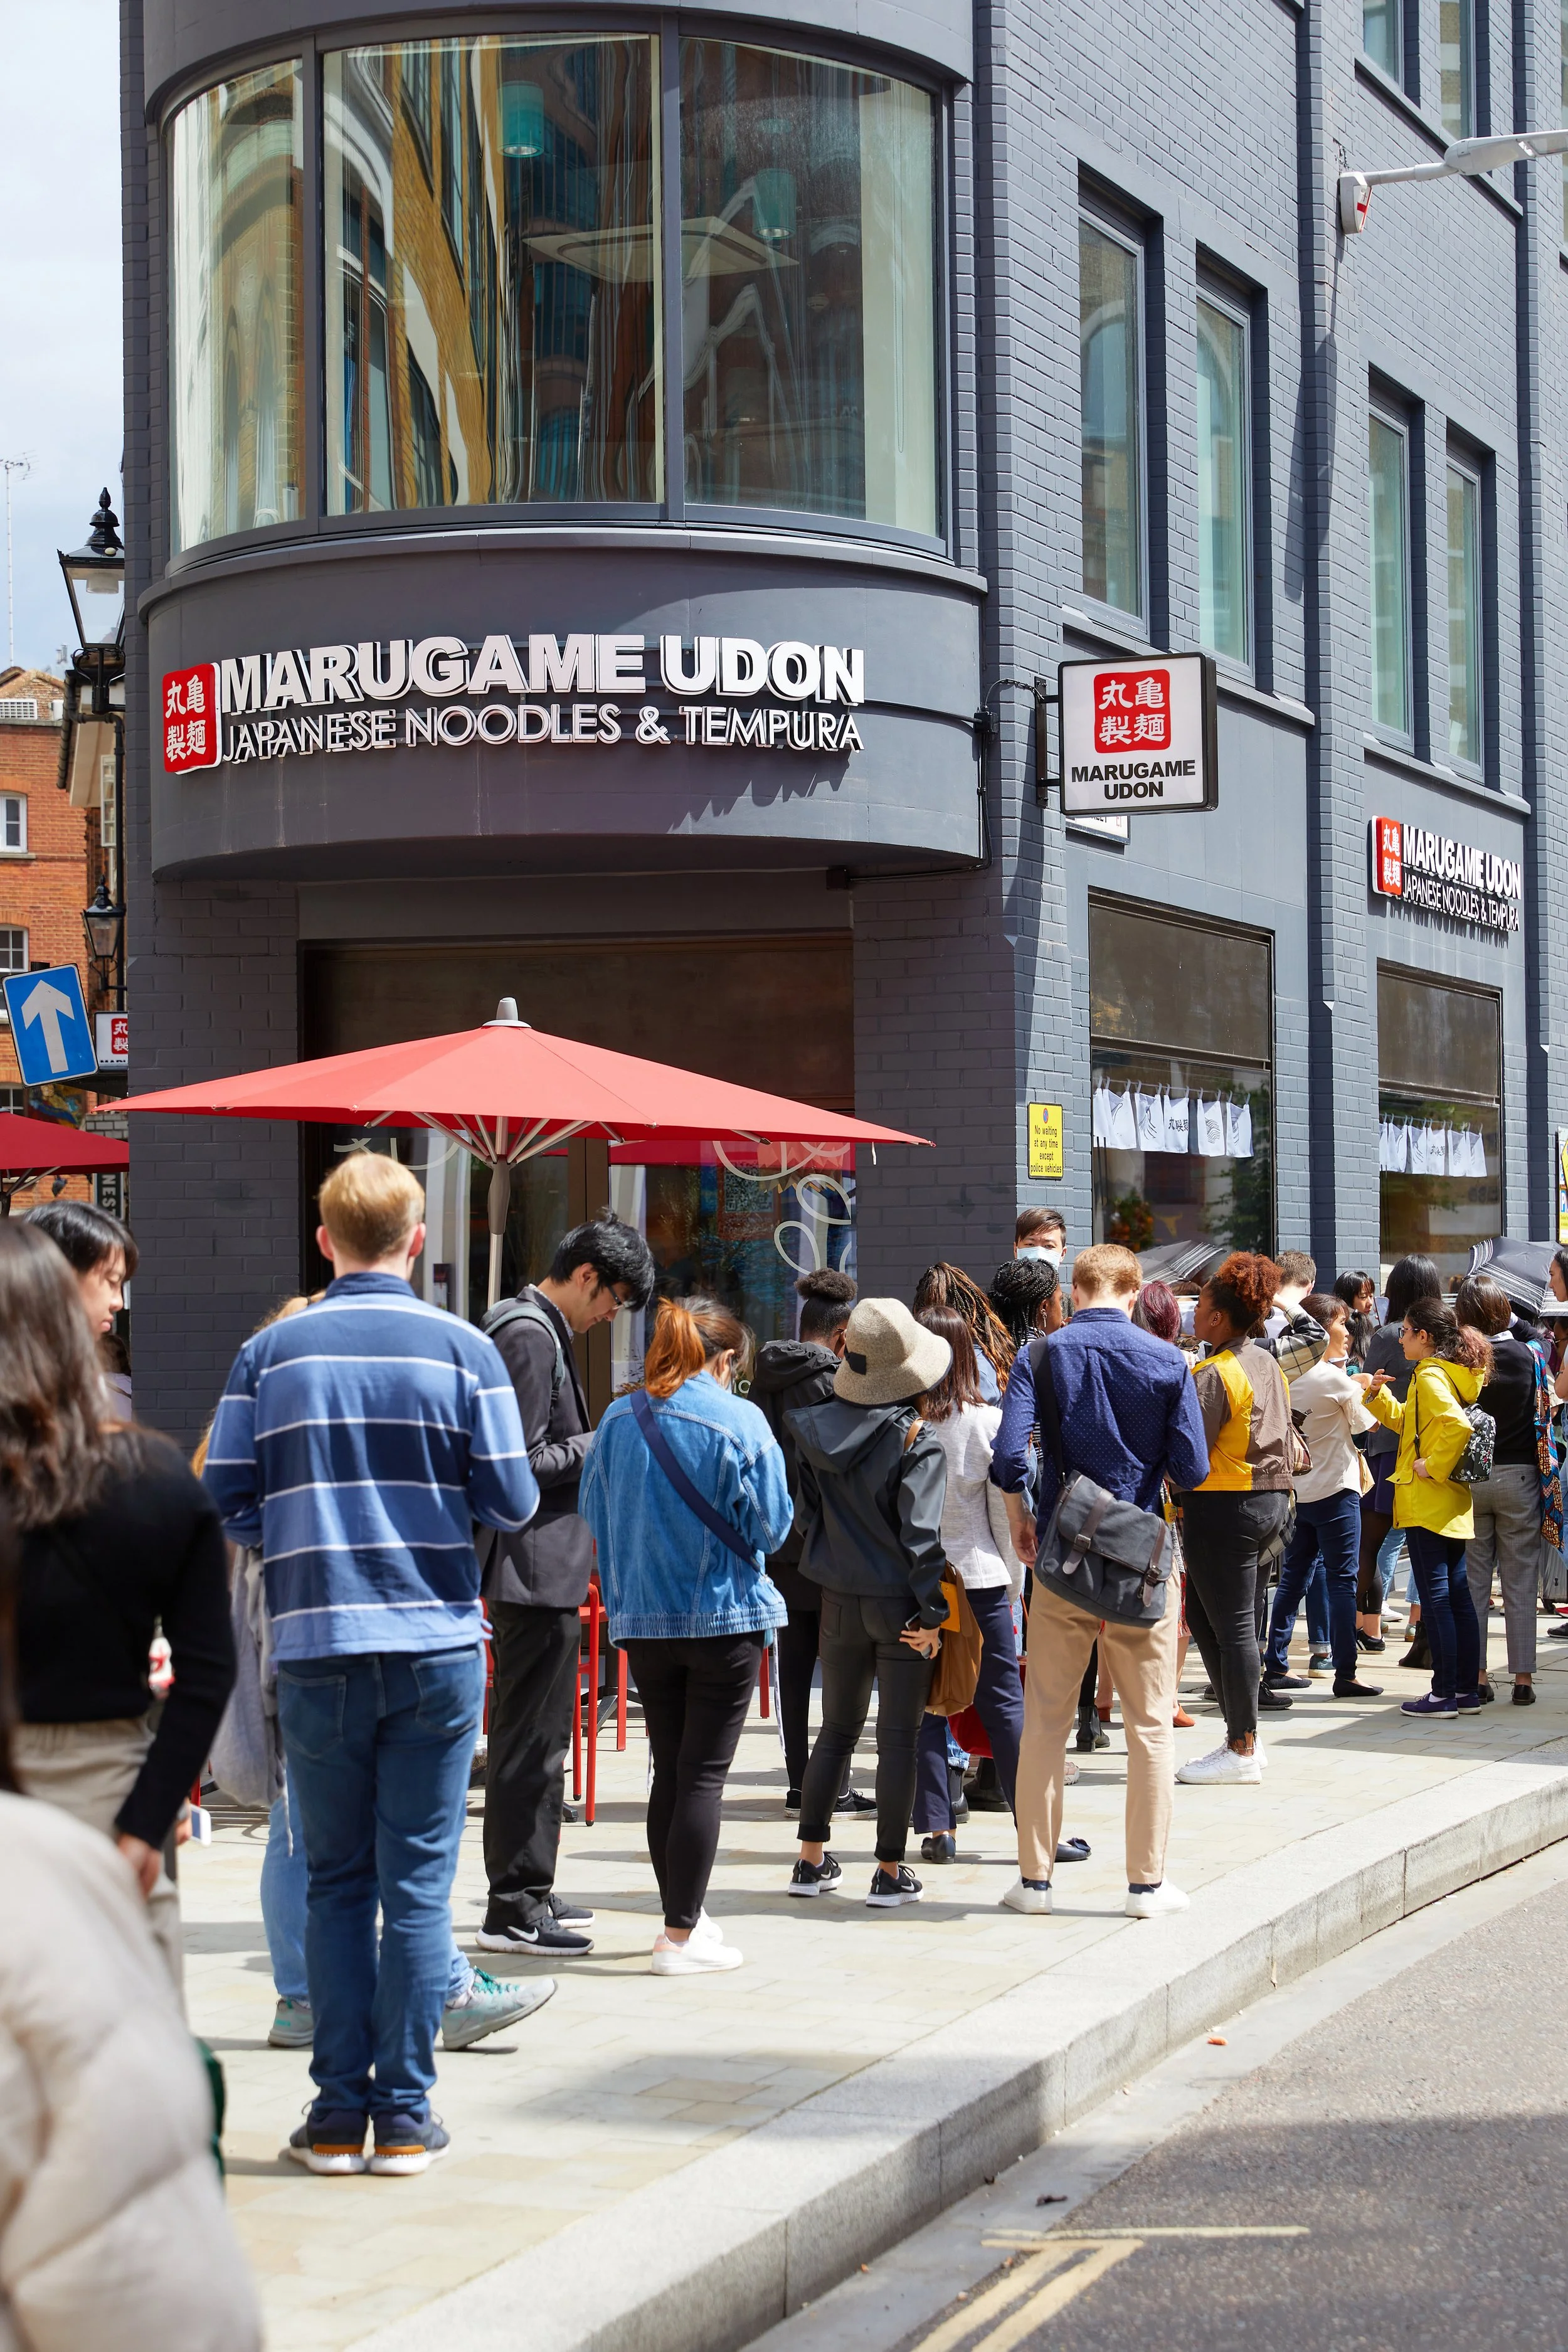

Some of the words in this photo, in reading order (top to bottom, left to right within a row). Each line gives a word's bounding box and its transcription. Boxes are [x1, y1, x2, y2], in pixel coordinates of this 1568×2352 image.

[221, 634, 646, 714] MARUGAME
[661, 635, 865, 705] UDON
[164, 674, 206, 719] 丸亀
[1098, 677, 1166, 710] 丸亀
[223, 709, 396, 763] JAPANESE
[405, 703, 622, 746] NOODLES
[635, 706, 671, 744] &
[679, 706, 864, 752] TEMPURA
[1071, 760, 1196, 783] MARUGAME
[1104, 781, 1163, 800] UDON
[1403, 823, 1485, 888] MARUGAME
[1485, 852, 1522, 900] UDON
[1402, 872, 1441, 908] JAPANESE
[1442, 884, 1480, 920] NOODLES
[1481, 898, 1487, 922] &
[1488, 899, 1520, 932] TEMPURA
[1034, 1125, 1041, 1135] No
[1042, 1126, 1057, 1138] waiting
[1034, 1138, 1039, 1147] at
[1040, 1140, 1048, 1150] any
[1049, 1138, 1058, 1148] time
[1030, 1163, 1043, 1174] police
[1044, 1163, 1062, 1173] vehicles
[1039, 1151, 1054, 1162] except
